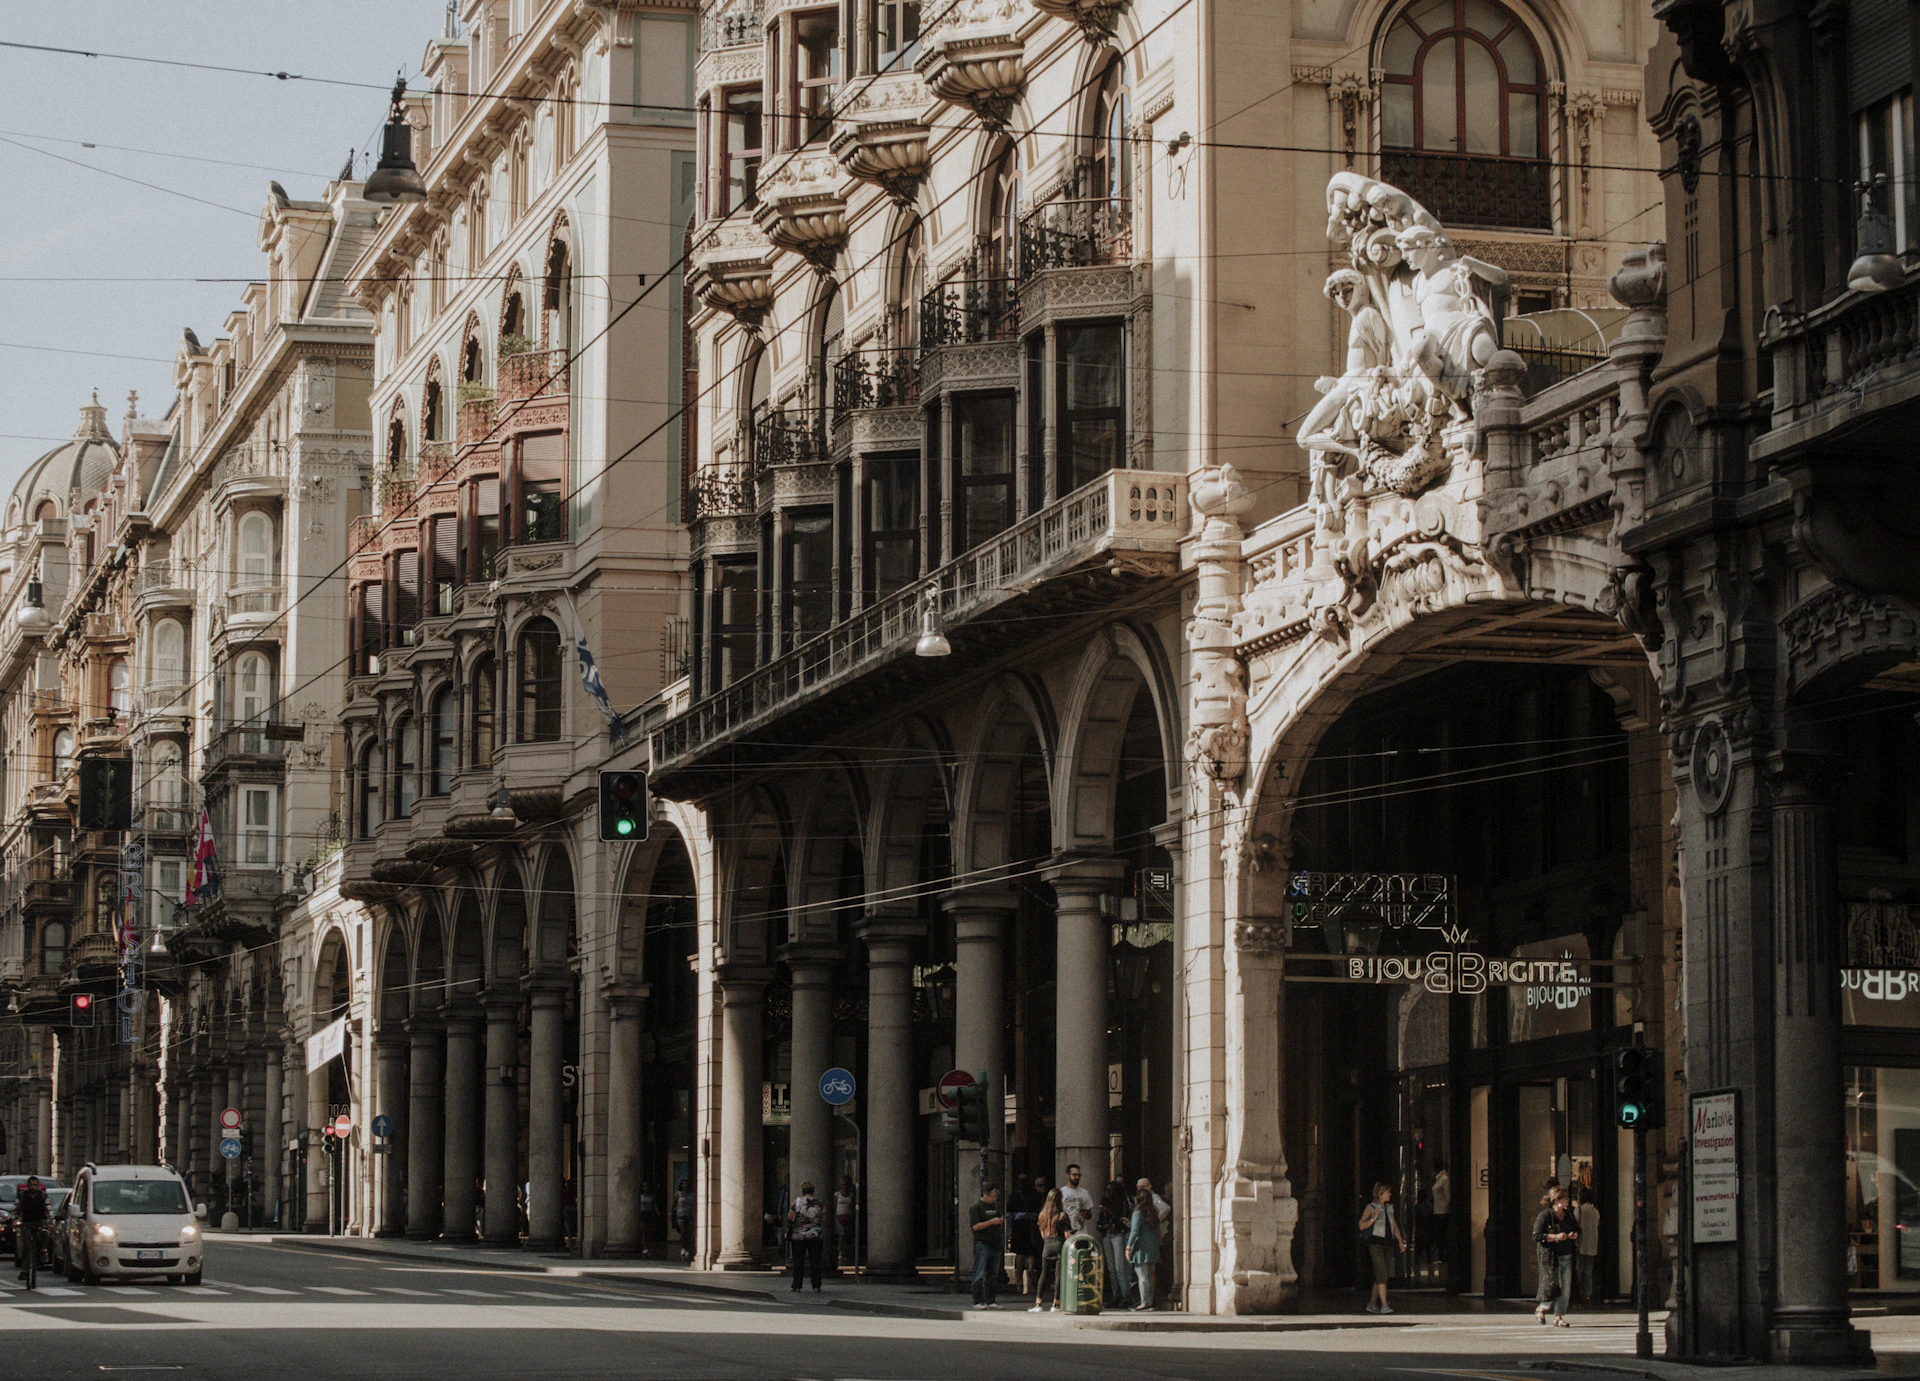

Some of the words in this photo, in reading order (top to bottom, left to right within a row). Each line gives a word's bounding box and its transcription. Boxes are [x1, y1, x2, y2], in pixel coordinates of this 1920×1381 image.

[118, 843, 143, 1043] BRISTOL
[1349, 958, 1421, 984] BIJOU
[1527, 985, 1555, 1010] BIJOU
[1694, 1135, 1735, 1151] Investigazioni
